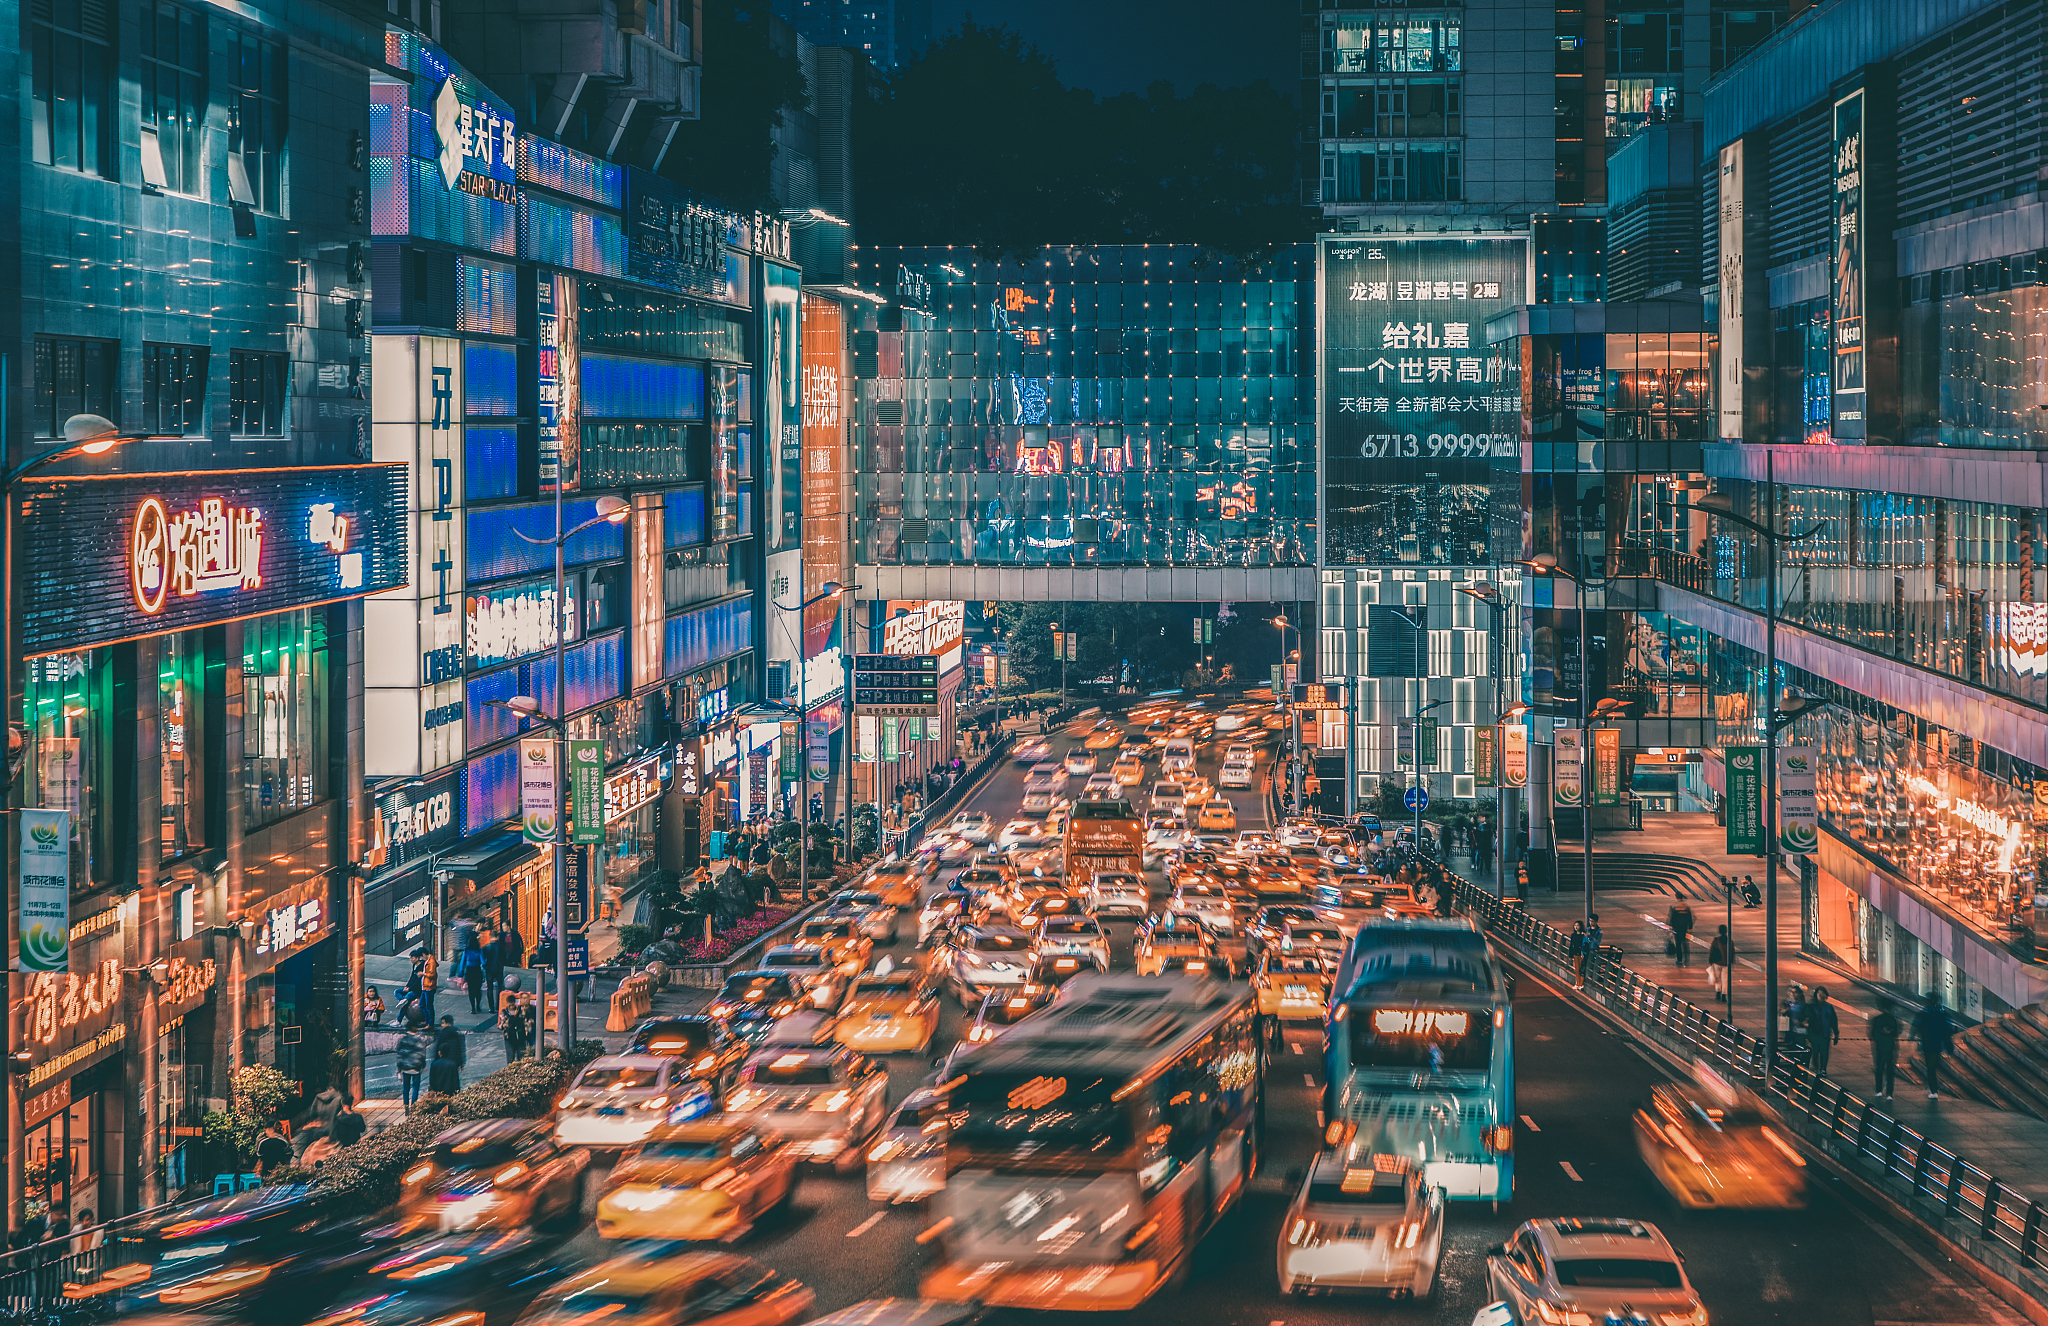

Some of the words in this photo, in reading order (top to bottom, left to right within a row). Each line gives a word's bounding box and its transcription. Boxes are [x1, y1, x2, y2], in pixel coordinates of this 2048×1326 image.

[460, 103, 515, 169] 星天广场
[460, 170, 485, 196] STAR
[488, 178, 517, 205] PLAZA
[755, 210, 790, 261] 星天广场
[1349, 282, 1387, 301] 龙湖
[1397, 281, 1468, 301] 昱湖壹号
[1473, 283, 1499, 298] 2期
[1382, 321, 1469, 349] 给礼嘉
[803, 364, 838, 430] 兄弟装饰
[1339, 397, 1389, 413] 天街旁
[1360, 434, 1419, 457] 6713
[1426, 434, 1490, 457] 9999
[874, 657, 882, 669] P
[884, 659, 919, 670] 北城天街
[874, 674, 882, 686] P
[874, 691, 883, 702] P
[1609, 750, 1617, 795] 花卉艺术博览会
[581, 767, 590, 828] 首届长江上游城市
[590, 767, 600, 828] 花卉艺术博览会
[1746, 775, 1756, 837] 花卉艺术博览会
[1782, 789, 1814, 797] 城市花博会
[428, 792, 450, 832] CGB
[23, 875, 65, 886] 城市花博会
